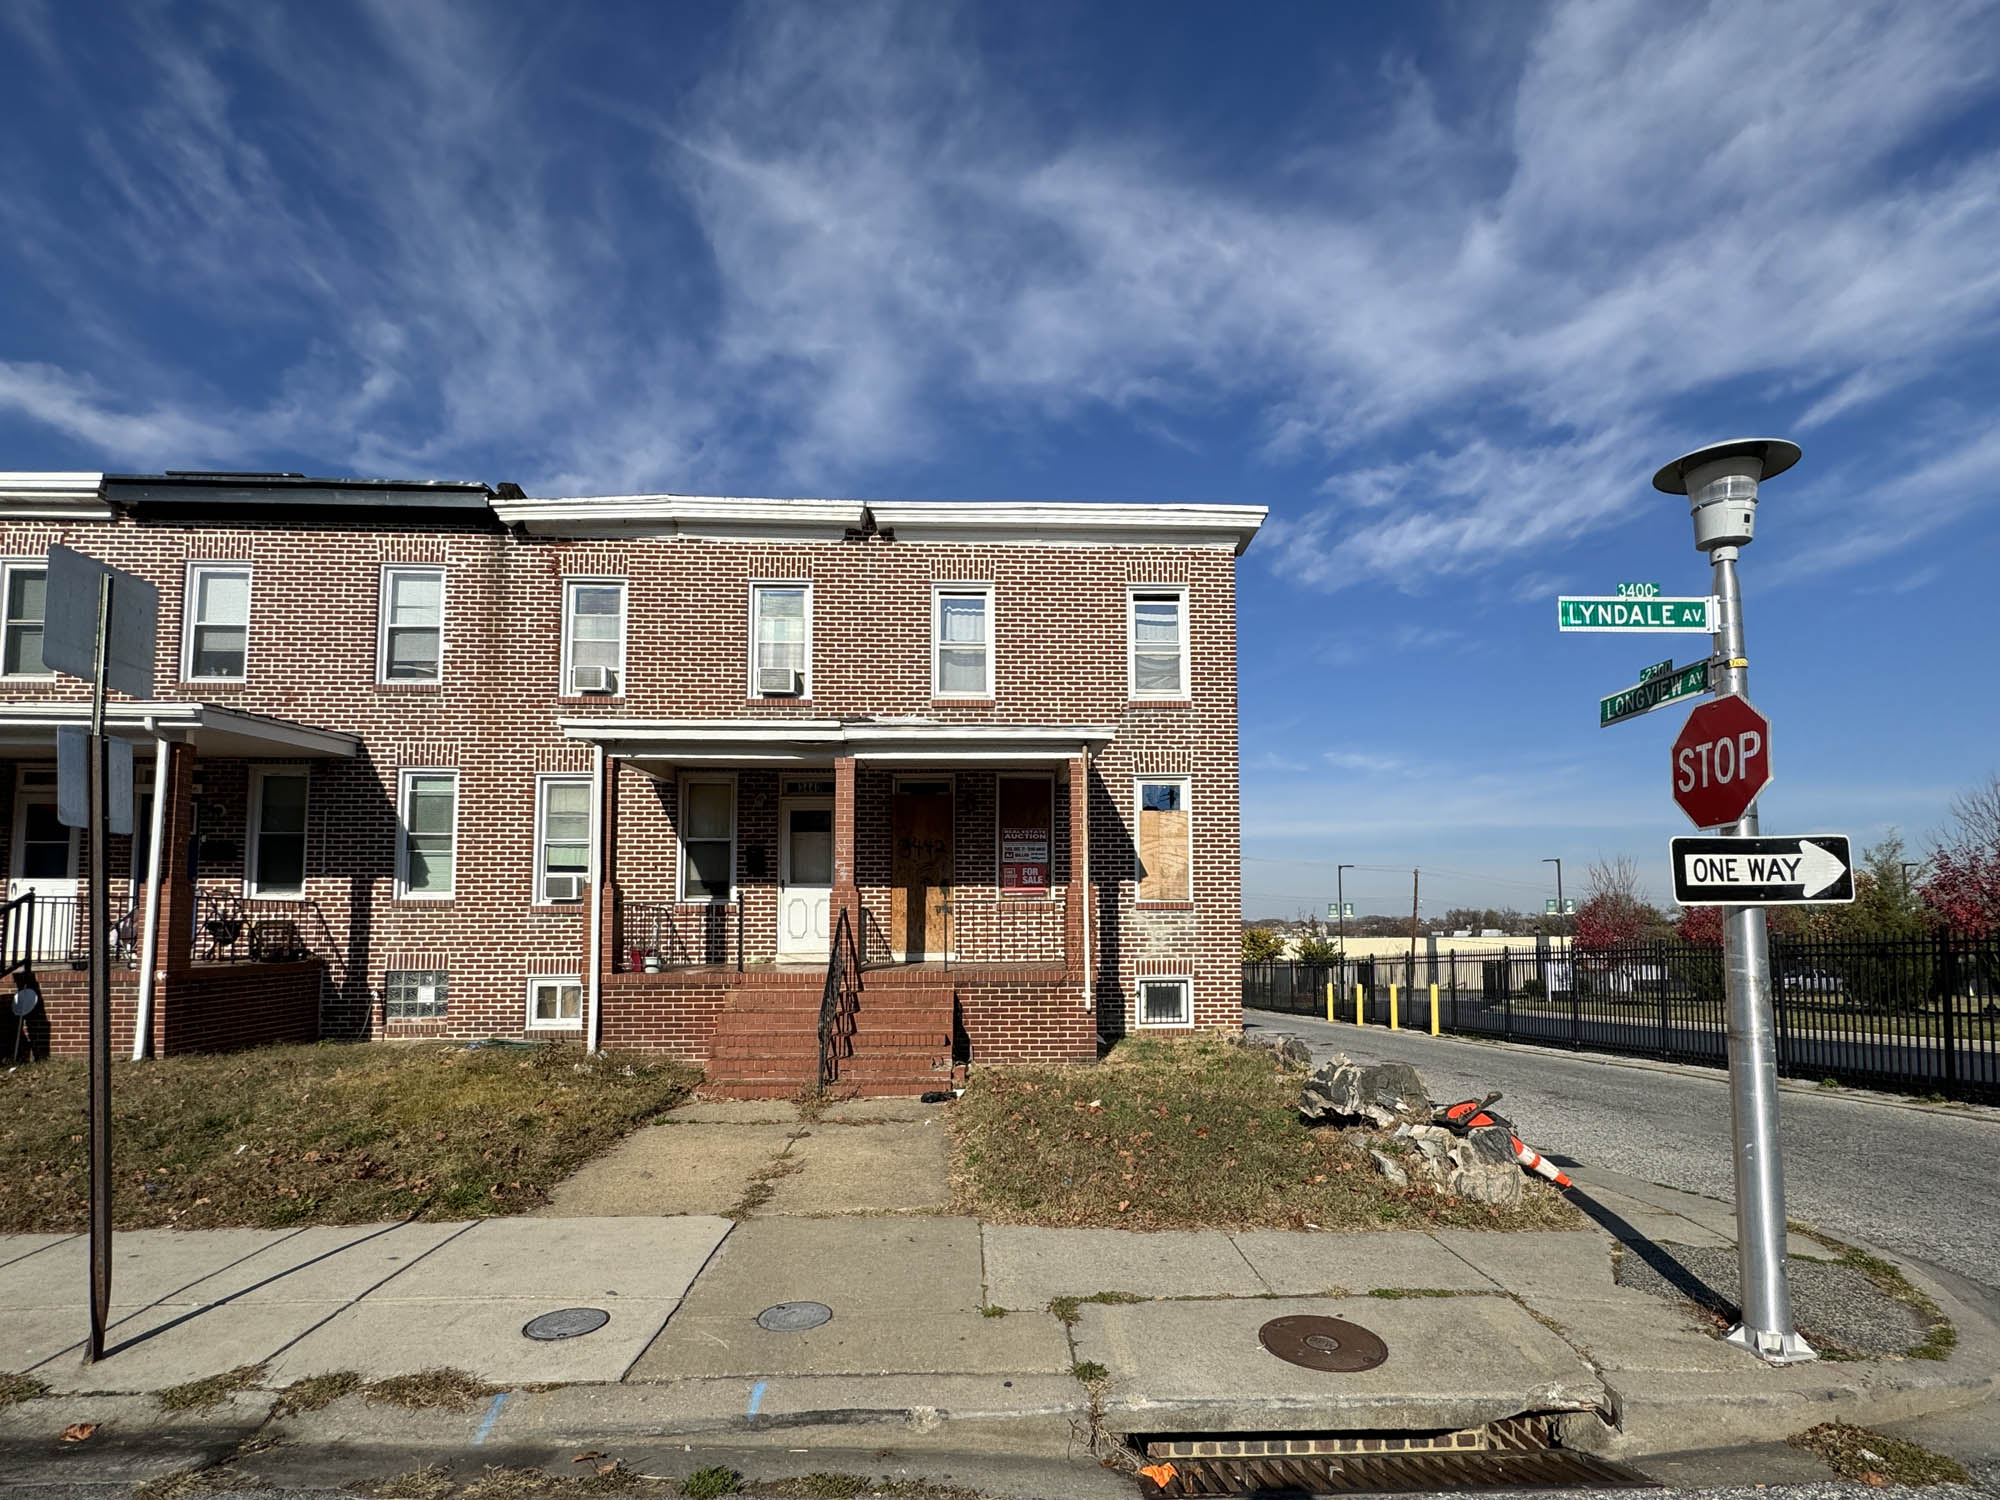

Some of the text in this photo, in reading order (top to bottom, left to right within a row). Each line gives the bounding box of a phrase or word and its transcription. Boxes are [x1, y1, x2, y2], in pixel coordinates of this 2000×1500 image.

[1618, 583, 1652, 597] 3400
[1569, 605, 1675, 625] LYNDALE
[1606, 675, 1683, 719] LONGVIEW
[1677, 730, 1761, 793] STOP
[1022, 867, 1038, 875] FOR
[1022, 875, 1043, 884] SALE
[1693, 857, 1802, 883] ONE WAY
